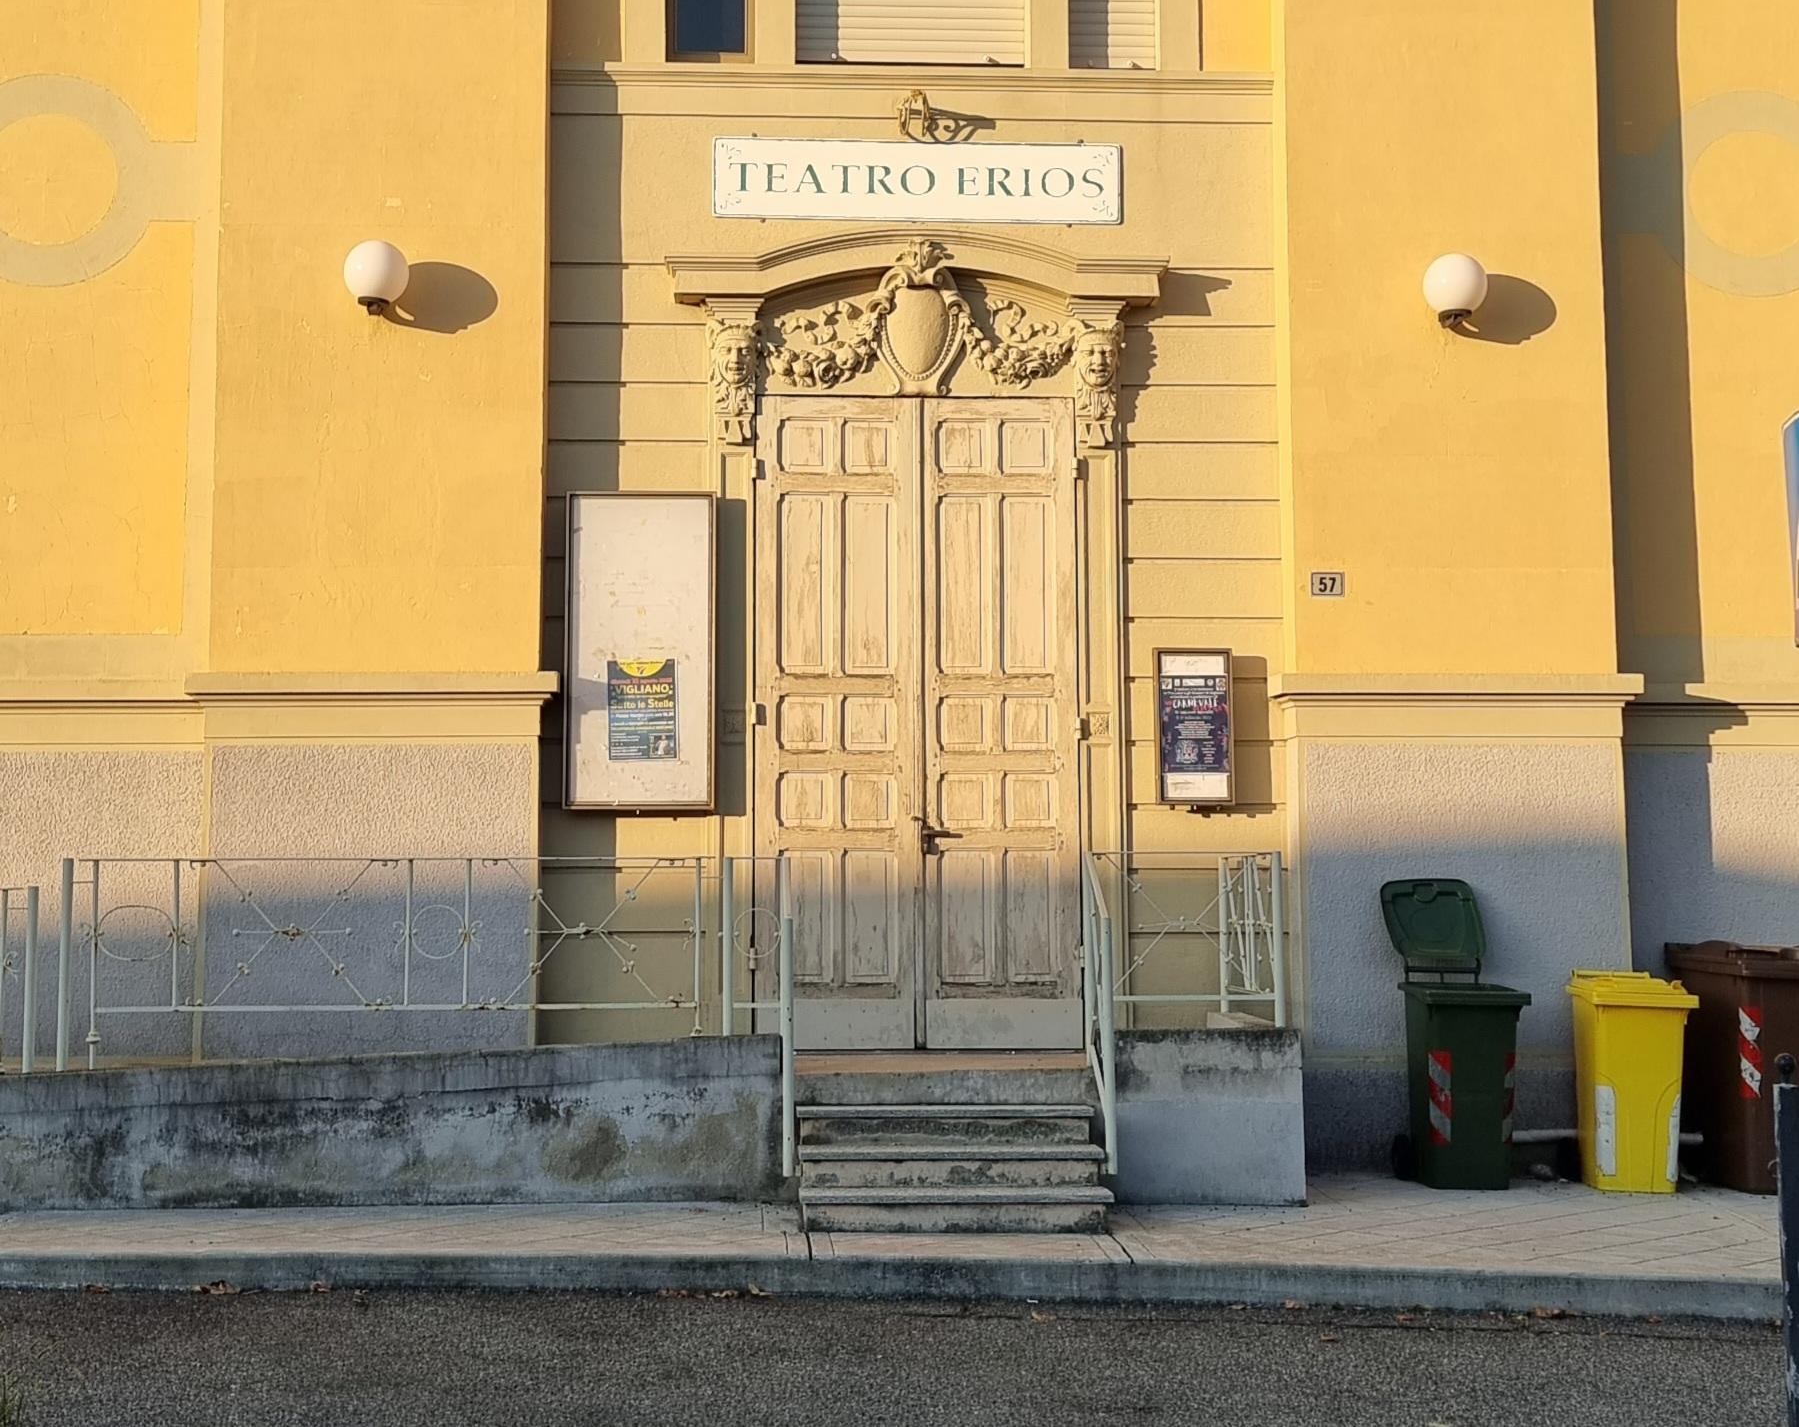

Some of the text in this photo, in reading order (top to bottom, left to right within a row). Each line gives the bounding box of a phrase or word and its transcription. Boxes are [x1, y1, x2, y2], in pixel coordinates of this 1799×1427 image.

[729, 162, 1105, 199] TEATRO ERIOS
[1318, 577, 1337, 592] 57
[615, 684, 670, 694] VIGLIANO
